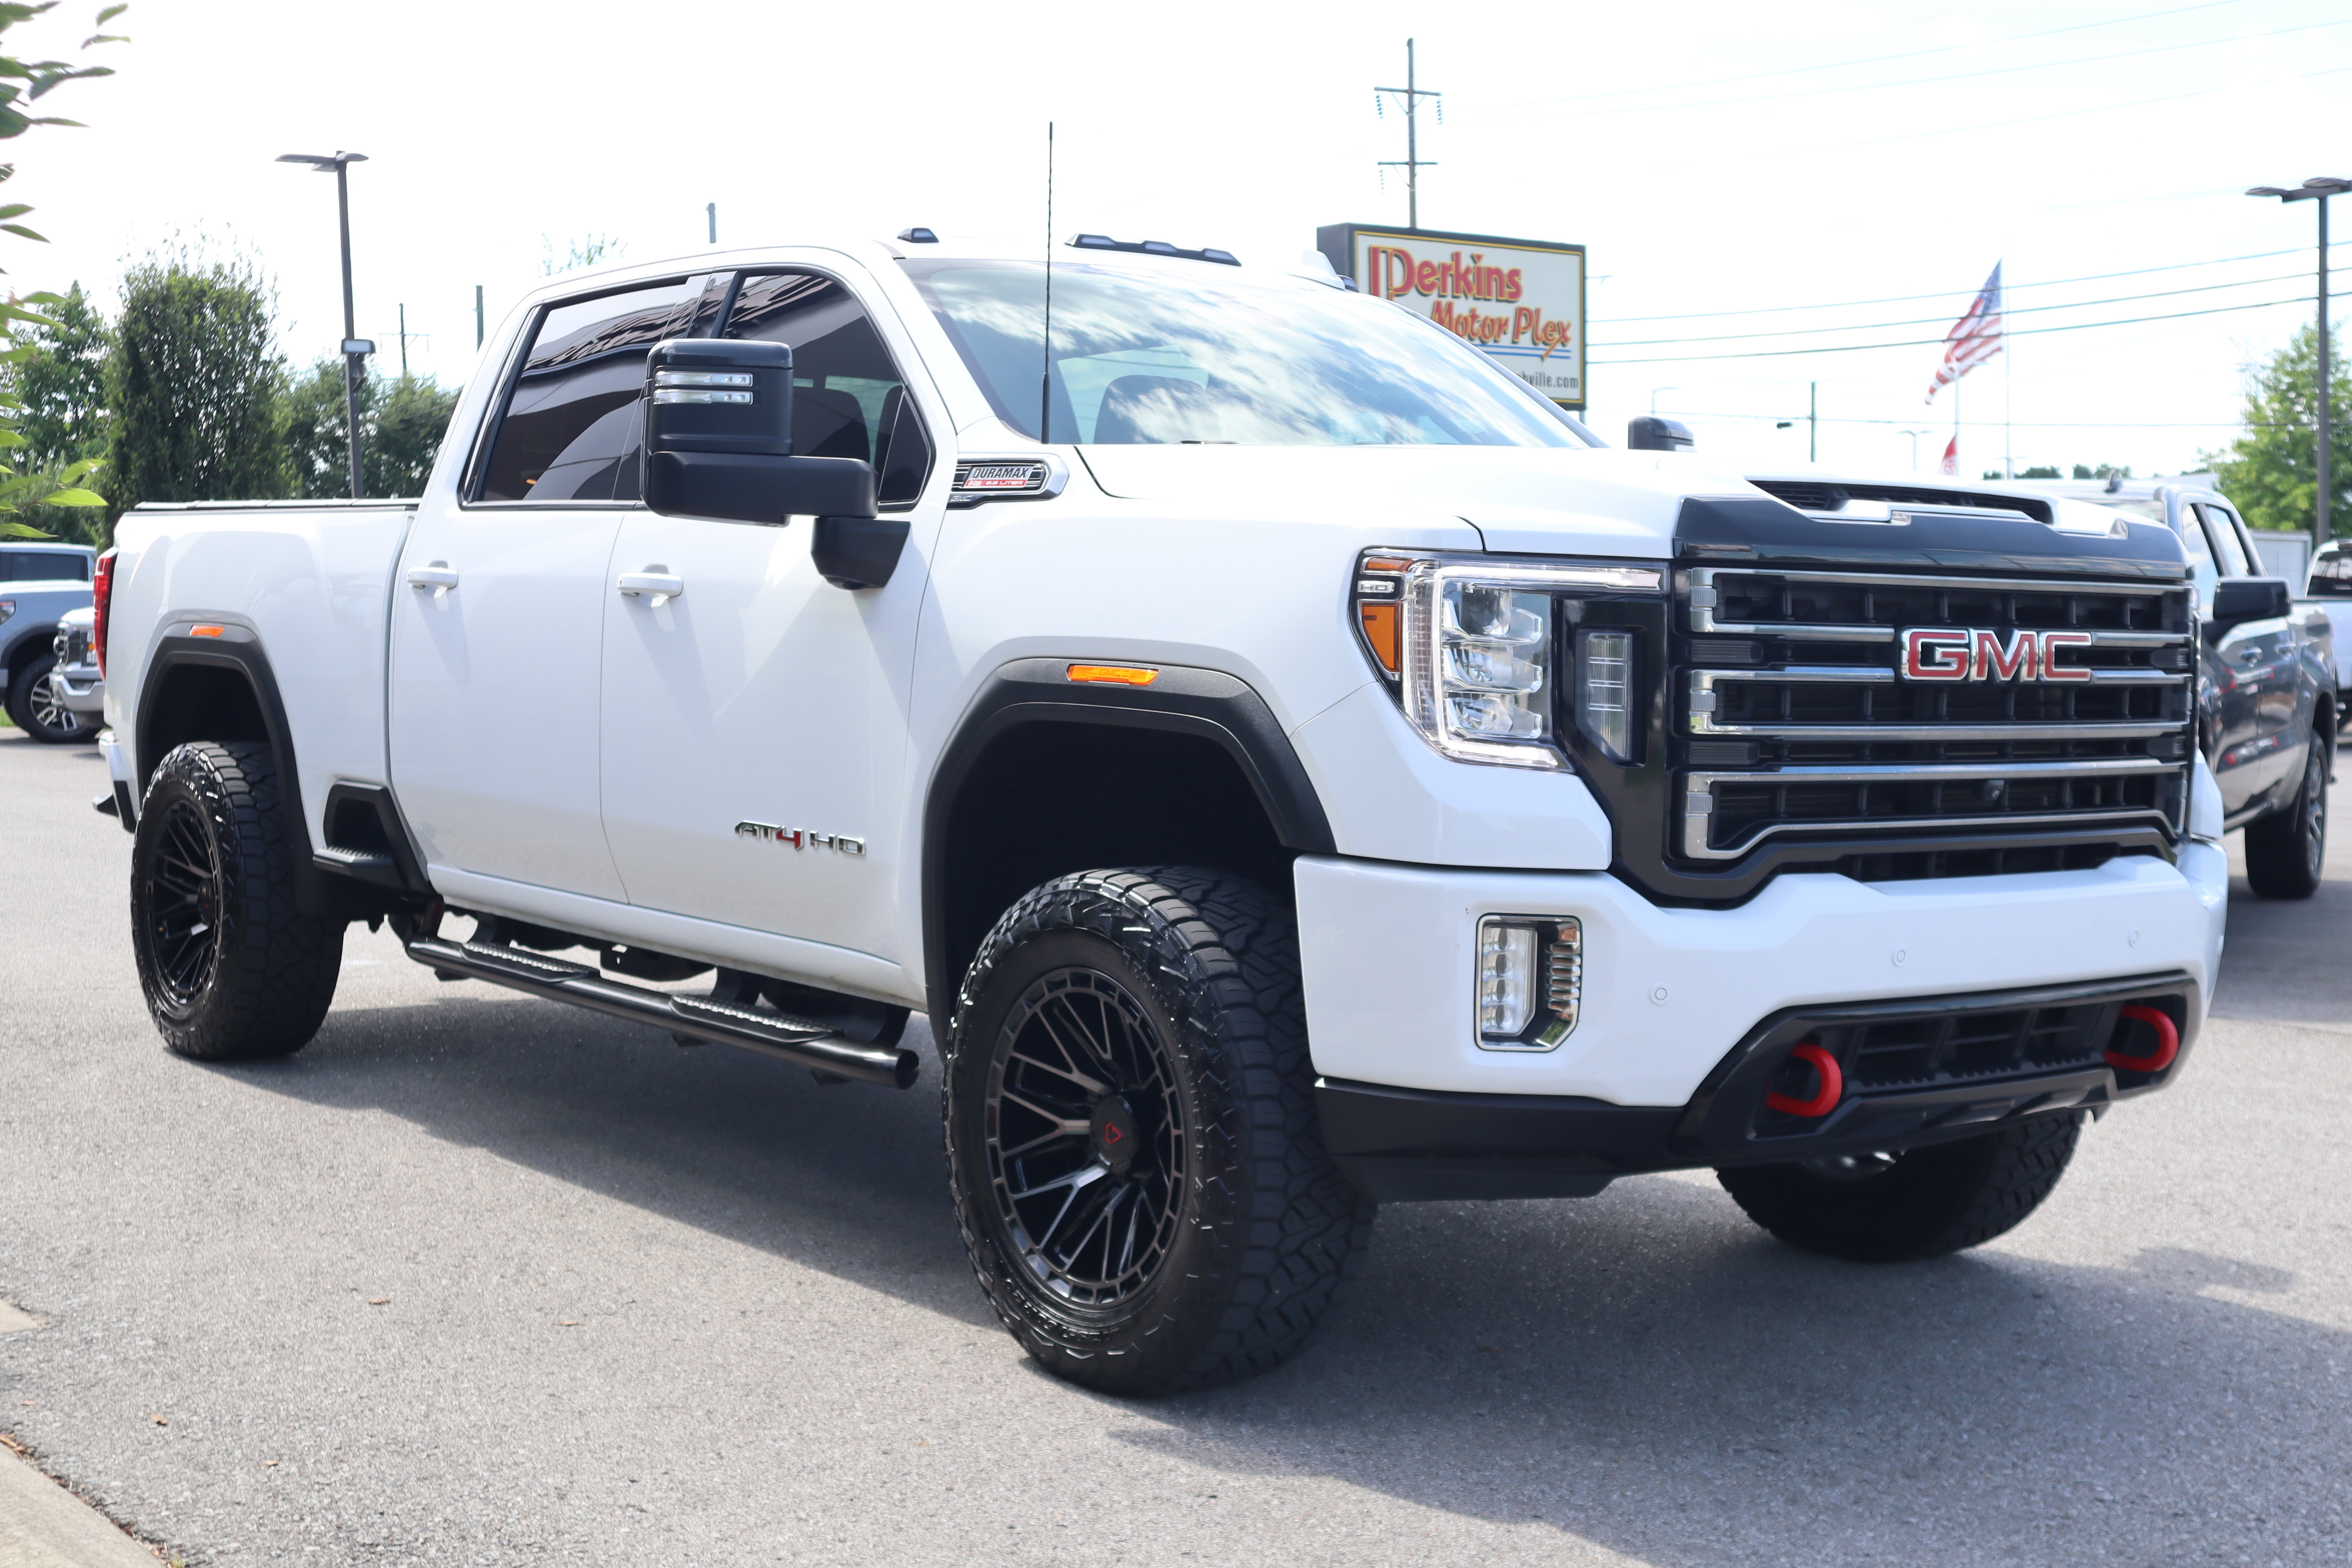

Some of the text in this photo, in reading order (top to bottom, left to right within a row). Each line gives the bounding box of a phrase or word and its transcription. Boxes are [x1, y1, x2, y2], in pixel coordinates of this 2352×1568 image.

[1369, 245, 1523, 302] Perkins
[1431, 301, 1572, 360] Motor Plex
[1516, 371, 1578, 388] hville.com
[973, 468, 1029, 478] DURAMAX
[1901, 626, 2092, 682] GMC
[735, 820, 866, 856] AT4 HD
